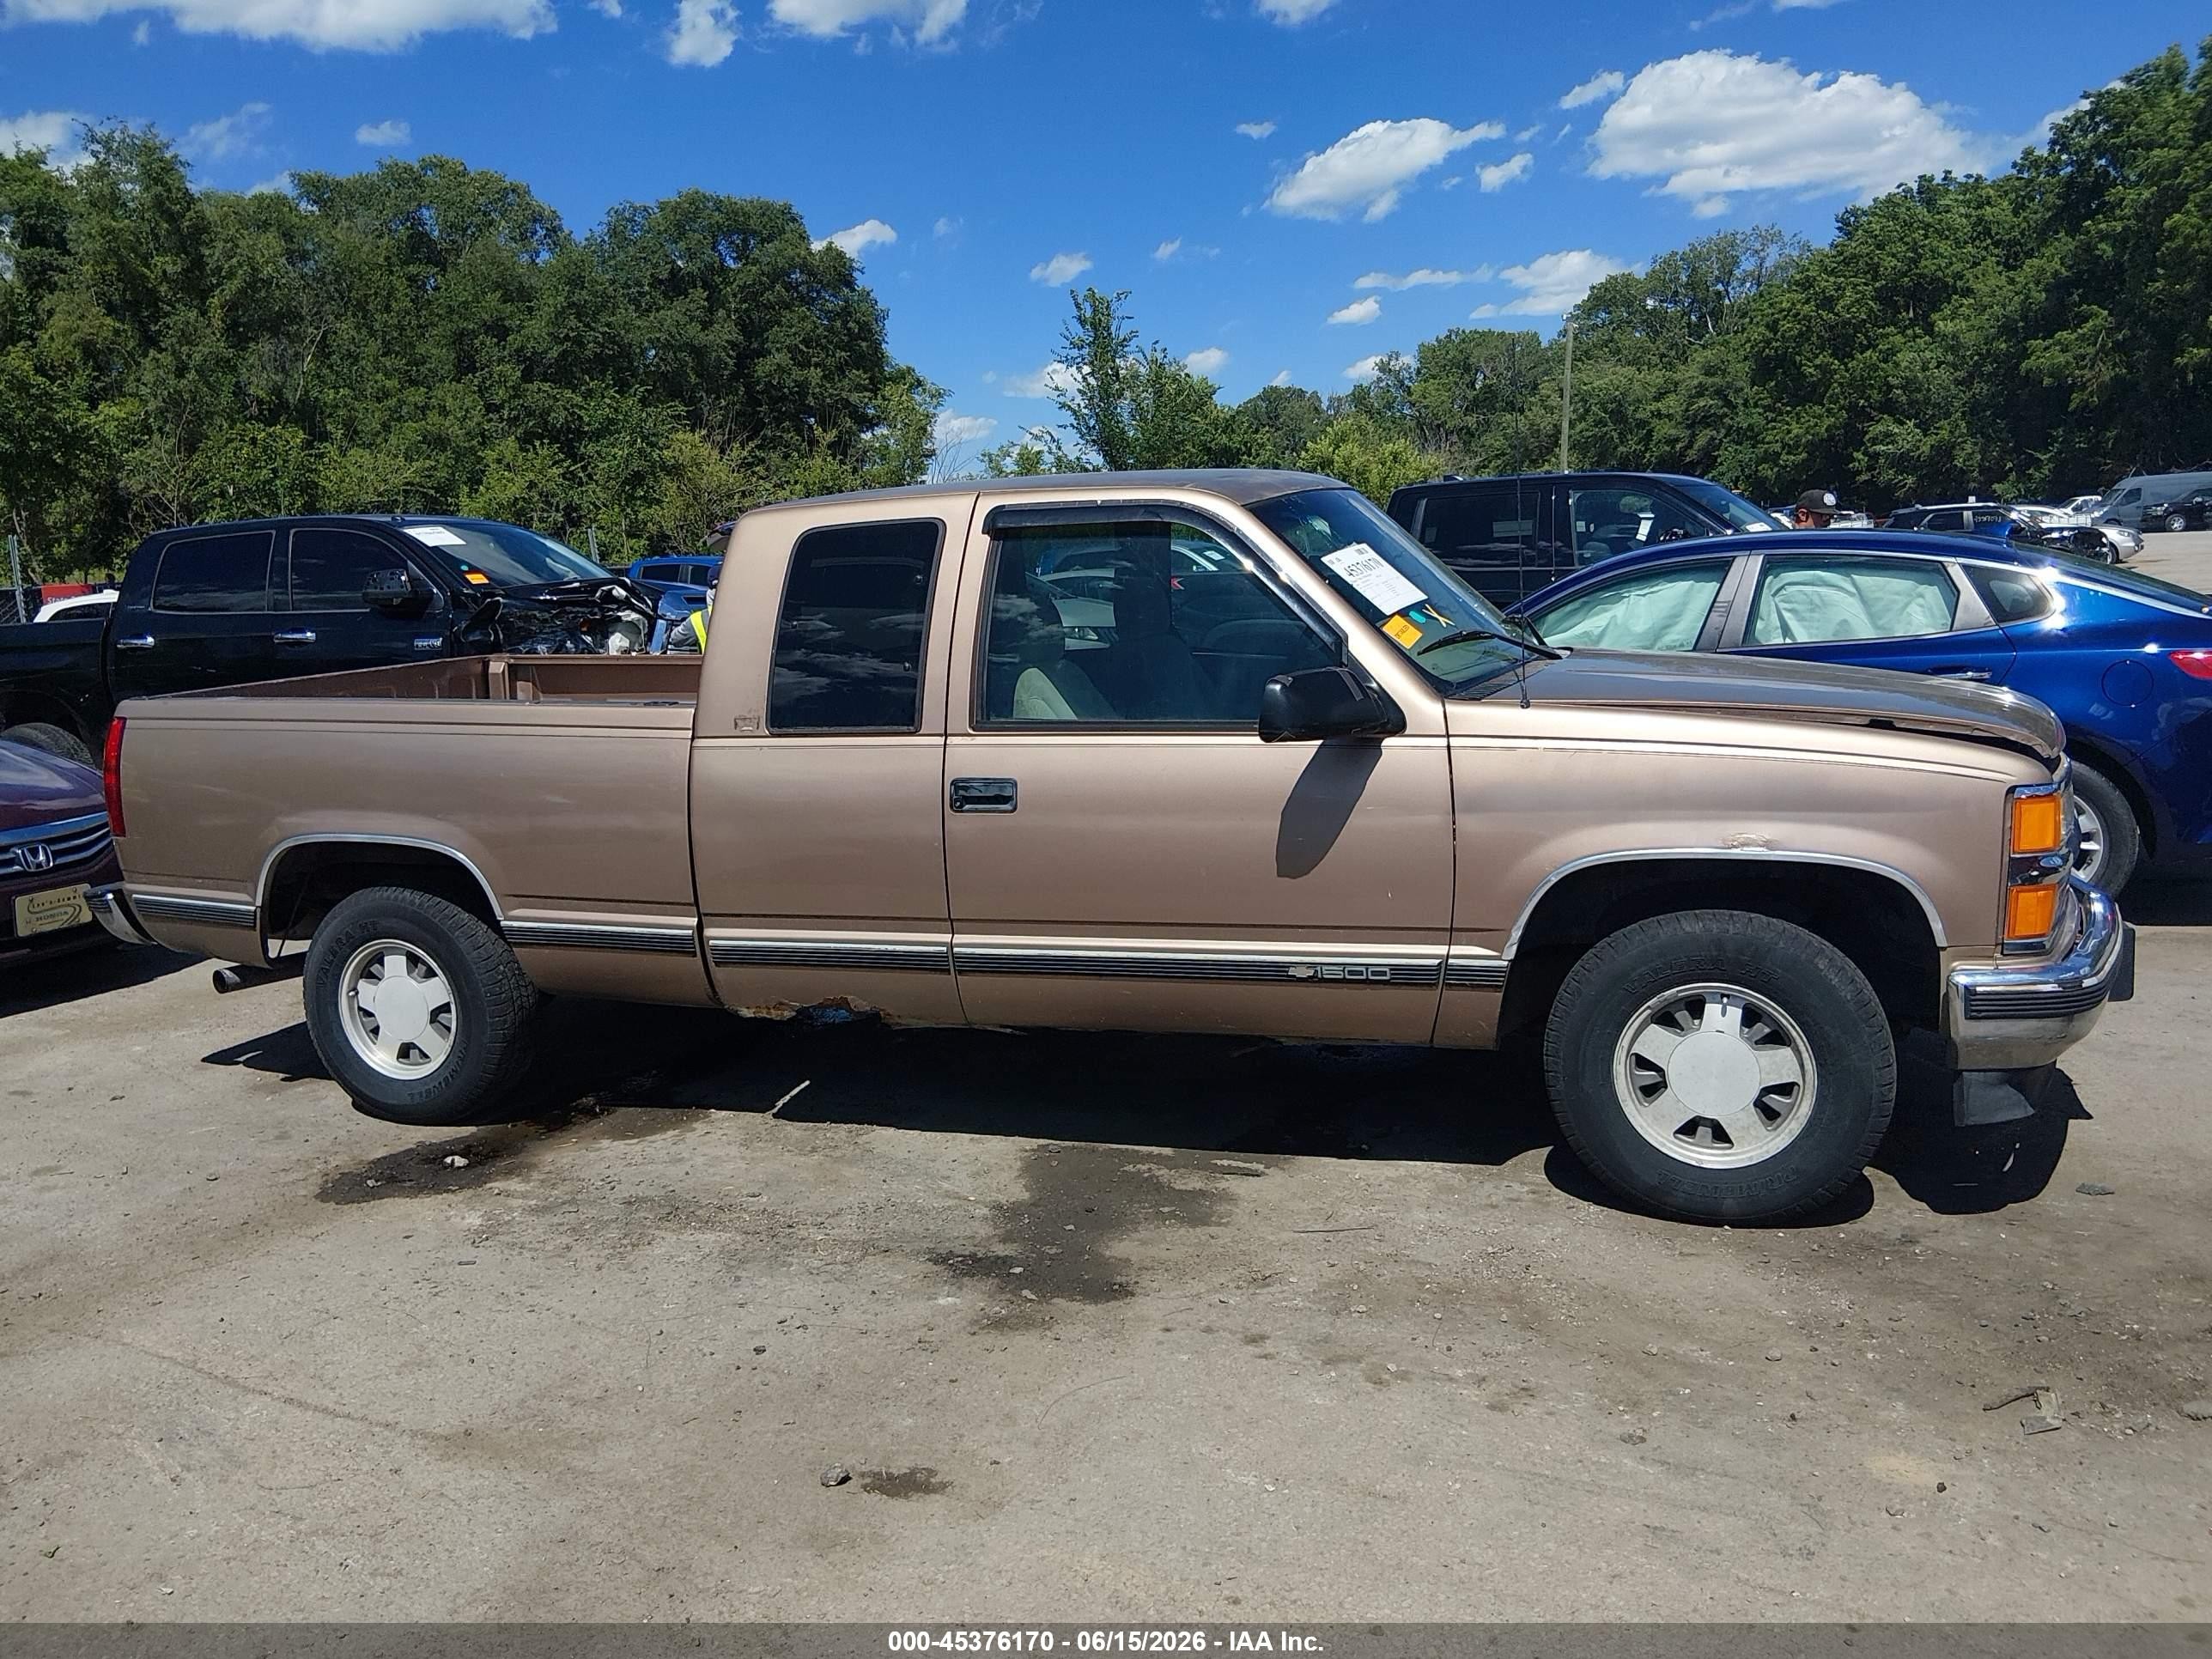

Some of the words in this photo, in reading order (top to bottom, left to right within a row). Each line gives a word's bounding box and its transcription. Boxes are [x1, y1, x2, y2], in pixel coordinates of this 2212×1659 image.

[1343, 556, 1385, 578] 45376170
[1316, 966, 1390, 980] 1500
[1622, 957, 1727, 994] VALERA
